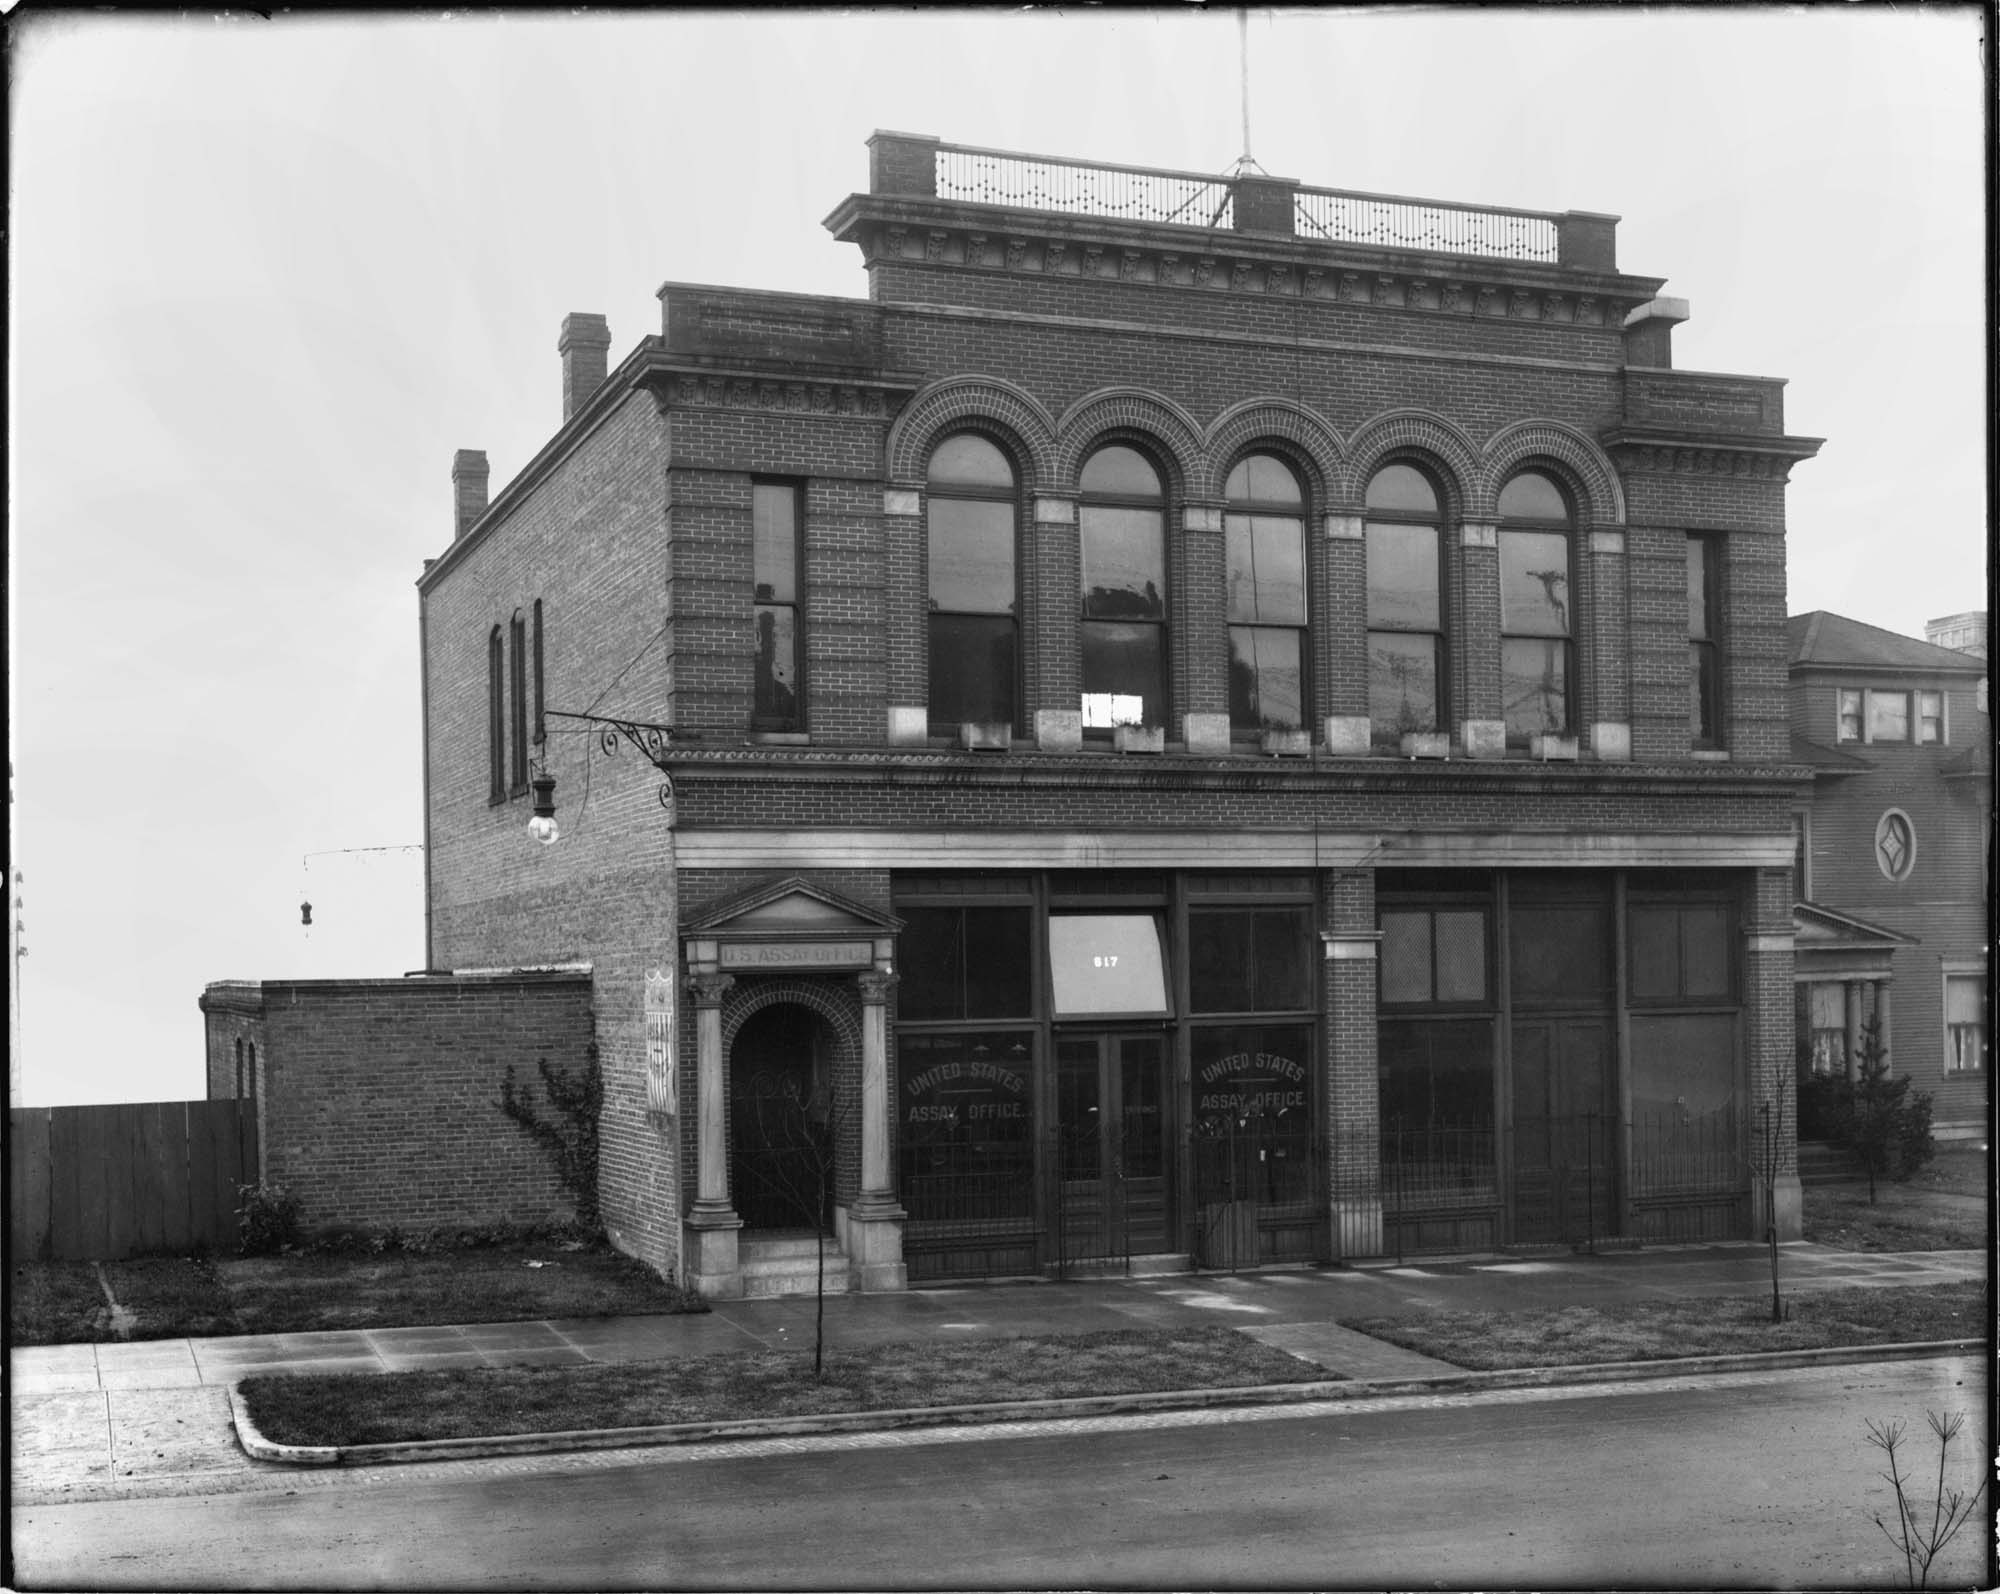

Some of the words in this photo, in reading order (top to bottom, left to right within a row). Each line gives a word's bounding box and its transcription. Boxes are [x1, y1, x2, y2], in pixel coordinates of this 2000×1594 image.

[907, 1062, 960, 1096] UNITED
[970, 1062, 1024, 1093] STATES
[1201, 1053, 1249, 1083] UNITED
[1255, 1052, 1305, 1082] STATES
